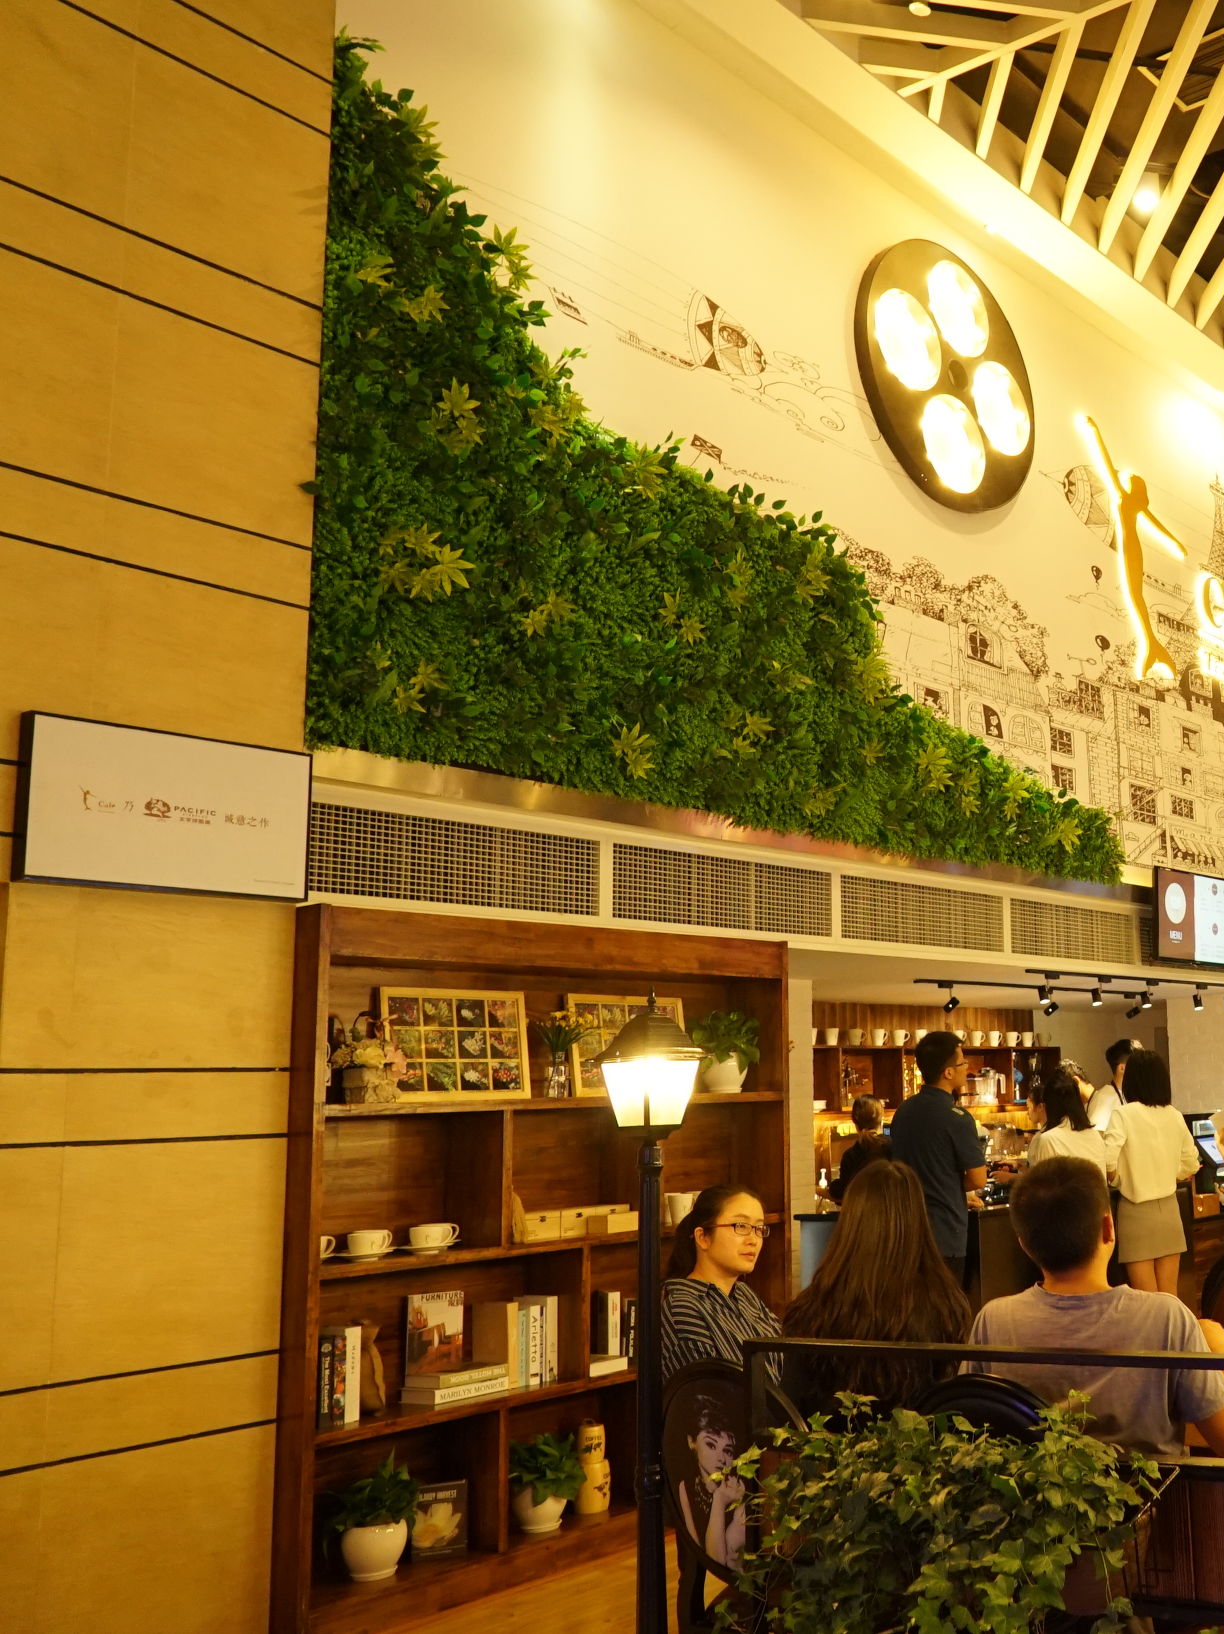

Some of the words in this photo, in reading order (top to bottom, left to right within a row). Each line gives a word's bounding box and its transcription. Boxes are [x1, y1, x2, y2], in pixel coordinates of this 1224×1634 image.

[174, 805, 217, 817] PACIFIC
[420, 1291, 464, 1302] FURNITURE
[439, 1387, 472, 1400] MARILYN
[474, 1381, 506, 1393] MONROE
